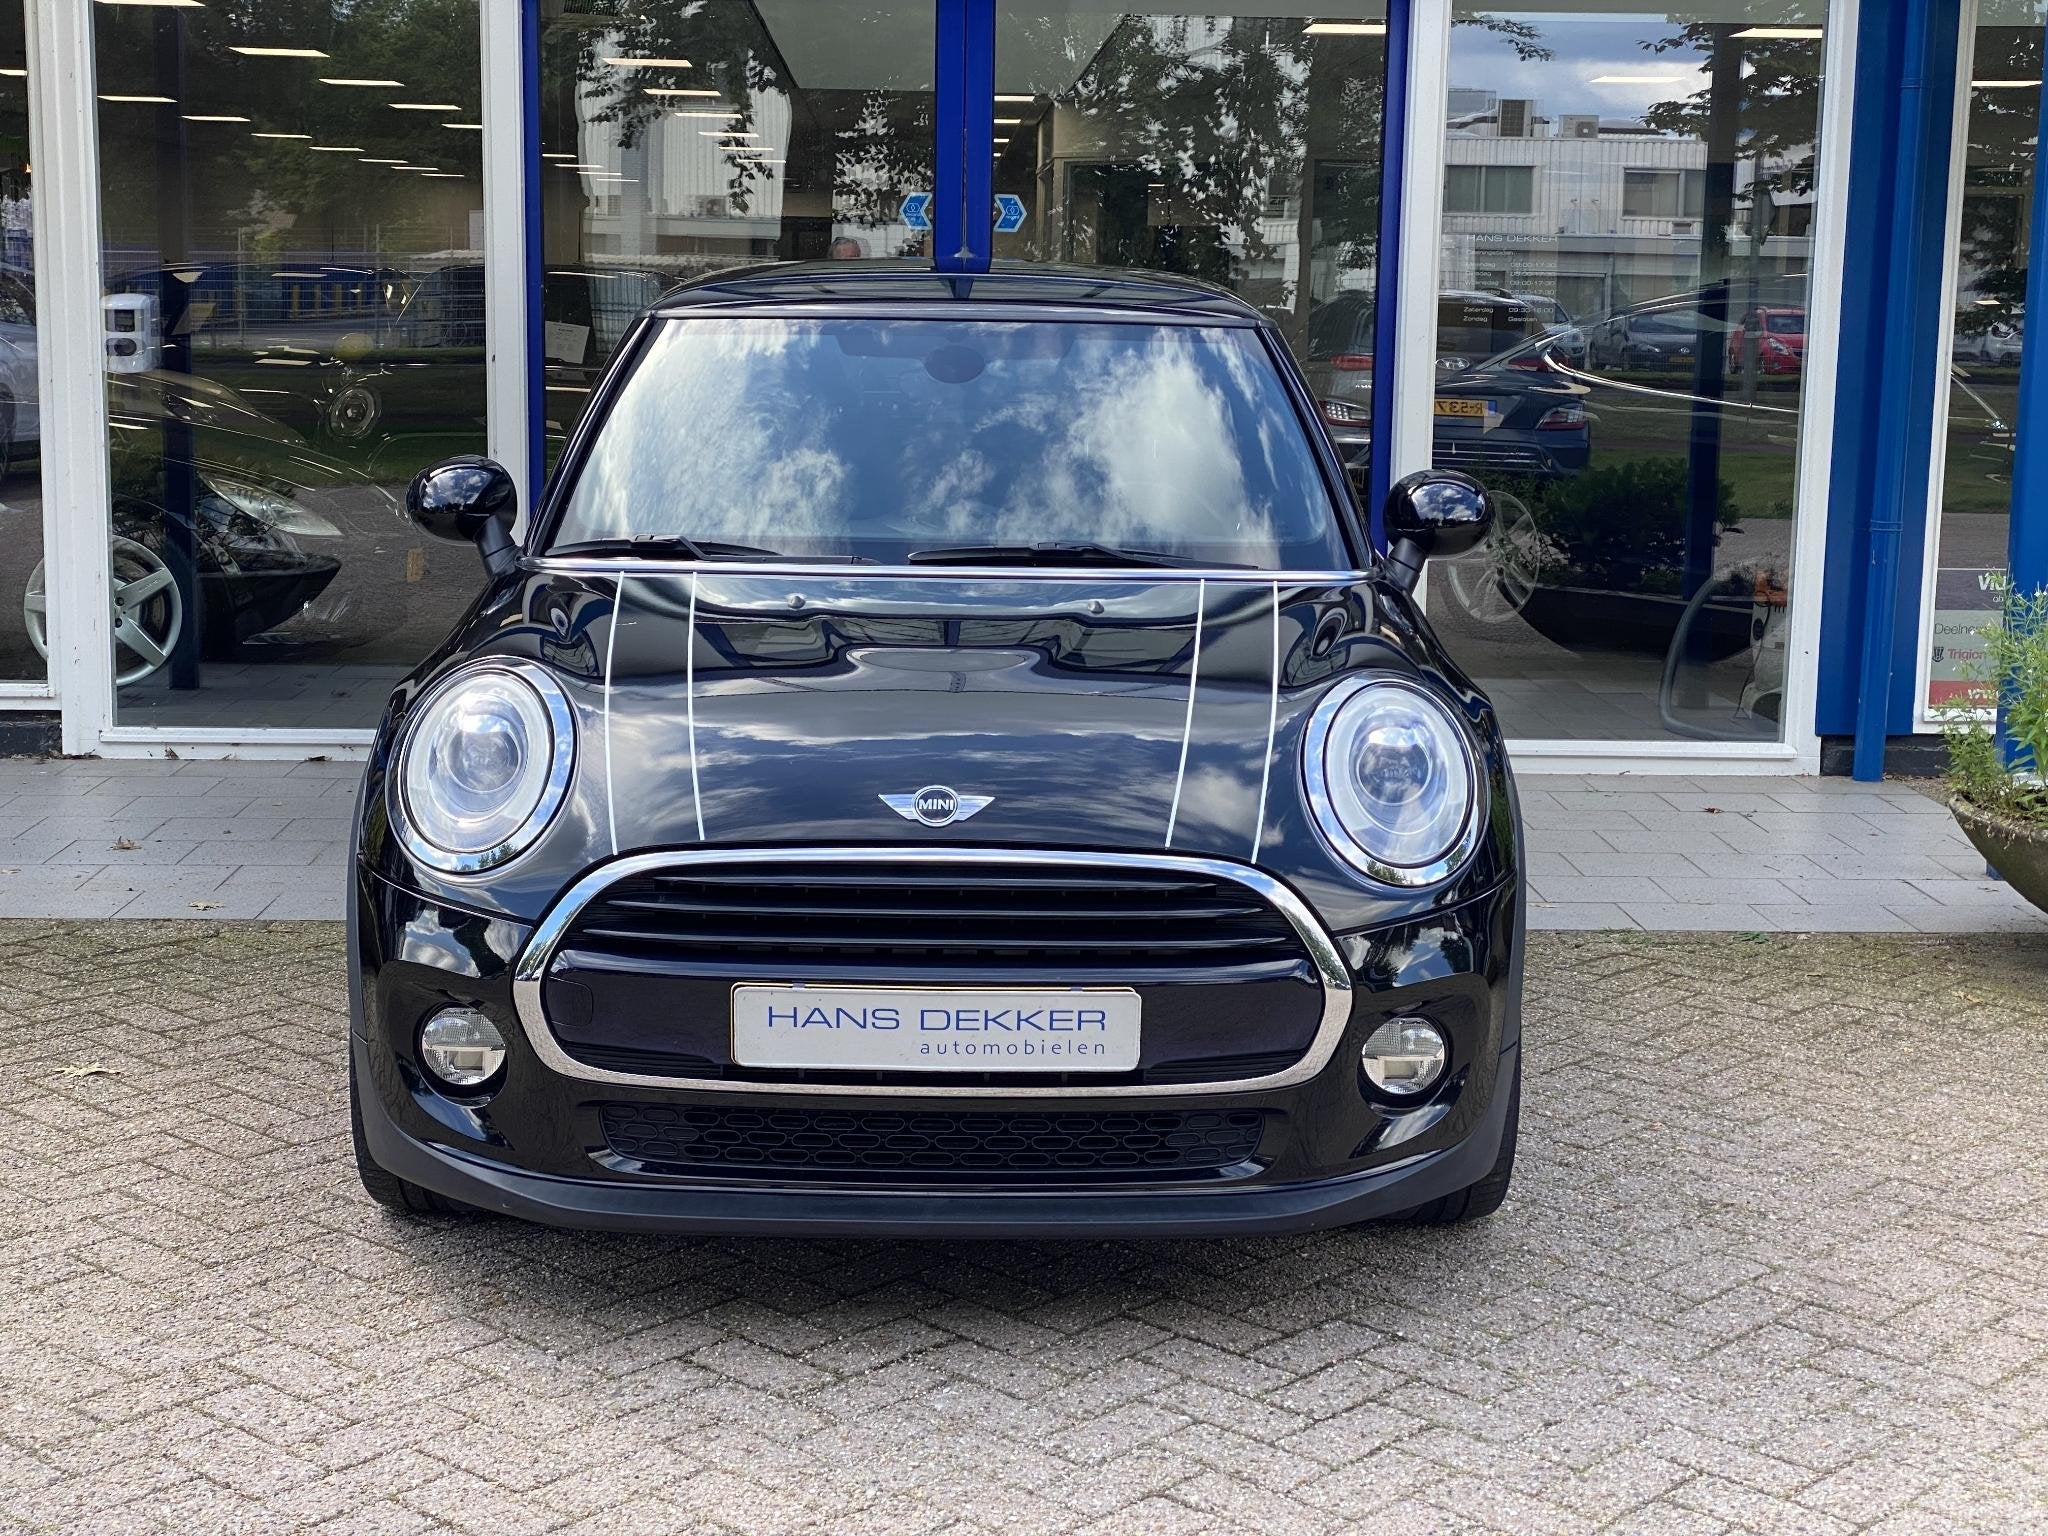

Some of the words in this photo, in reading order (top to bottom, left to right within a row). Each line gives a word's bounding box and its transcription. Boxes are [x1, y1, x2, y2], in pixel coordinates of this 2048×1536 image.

[1466, 234, 1503, 242] HANS
[1506, 234, 1558, 243] DEKKER
[1935, 623, 1978, 635] Deelne
[918, 798, 954, 810] MINI
[768, 1006, 900, 1030] HANS
[920, 1009, 1106, 1032] DEKKER
[920, 1039, 1105, 1055] automobielen
